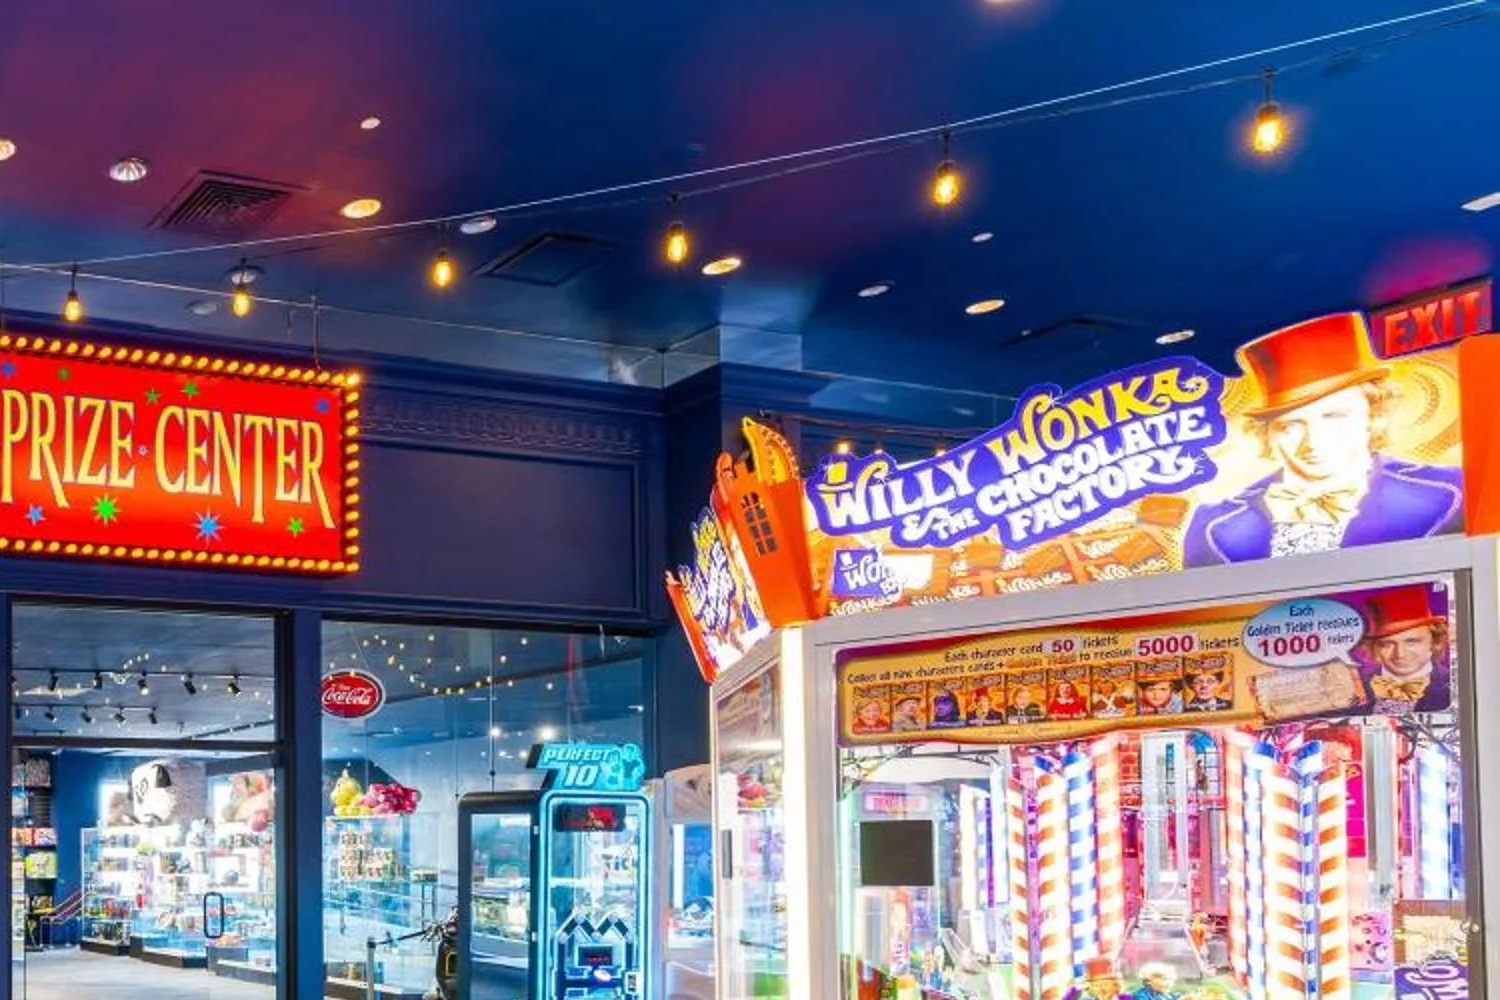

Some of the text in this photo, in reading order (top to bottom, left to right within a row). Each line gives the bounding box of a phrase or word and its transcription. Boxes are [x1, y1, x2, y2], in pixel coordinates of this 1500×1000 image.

[1384, 290, 1481, 357] EXIT
[1, 388, 337, 530] PRIZE CENTER
[818, 367, 1209, 528] WILLY WONKA
[975, 406, 1212, 517] CHOCOLATE
[1005, 445, 1197, 542] FACTORY
[1285, 621, 1314, 634] Ticket
[1288, 603, 1315, 618] Each
[944, 650, 969, 663] Each
[1019, 642, 1043, 654] card
[1051, 639, 1075, 653] 50
[1083, 634, 1119, 649] tickets
[1079, 651, 1091, 661] to
[1137, 635, 1195, 657] 5000
[1200, 636, 1239, 650] tickets
[1258, 634, 1321, 658] 1000
[543, 746, 613, 787] PERFECT 10
